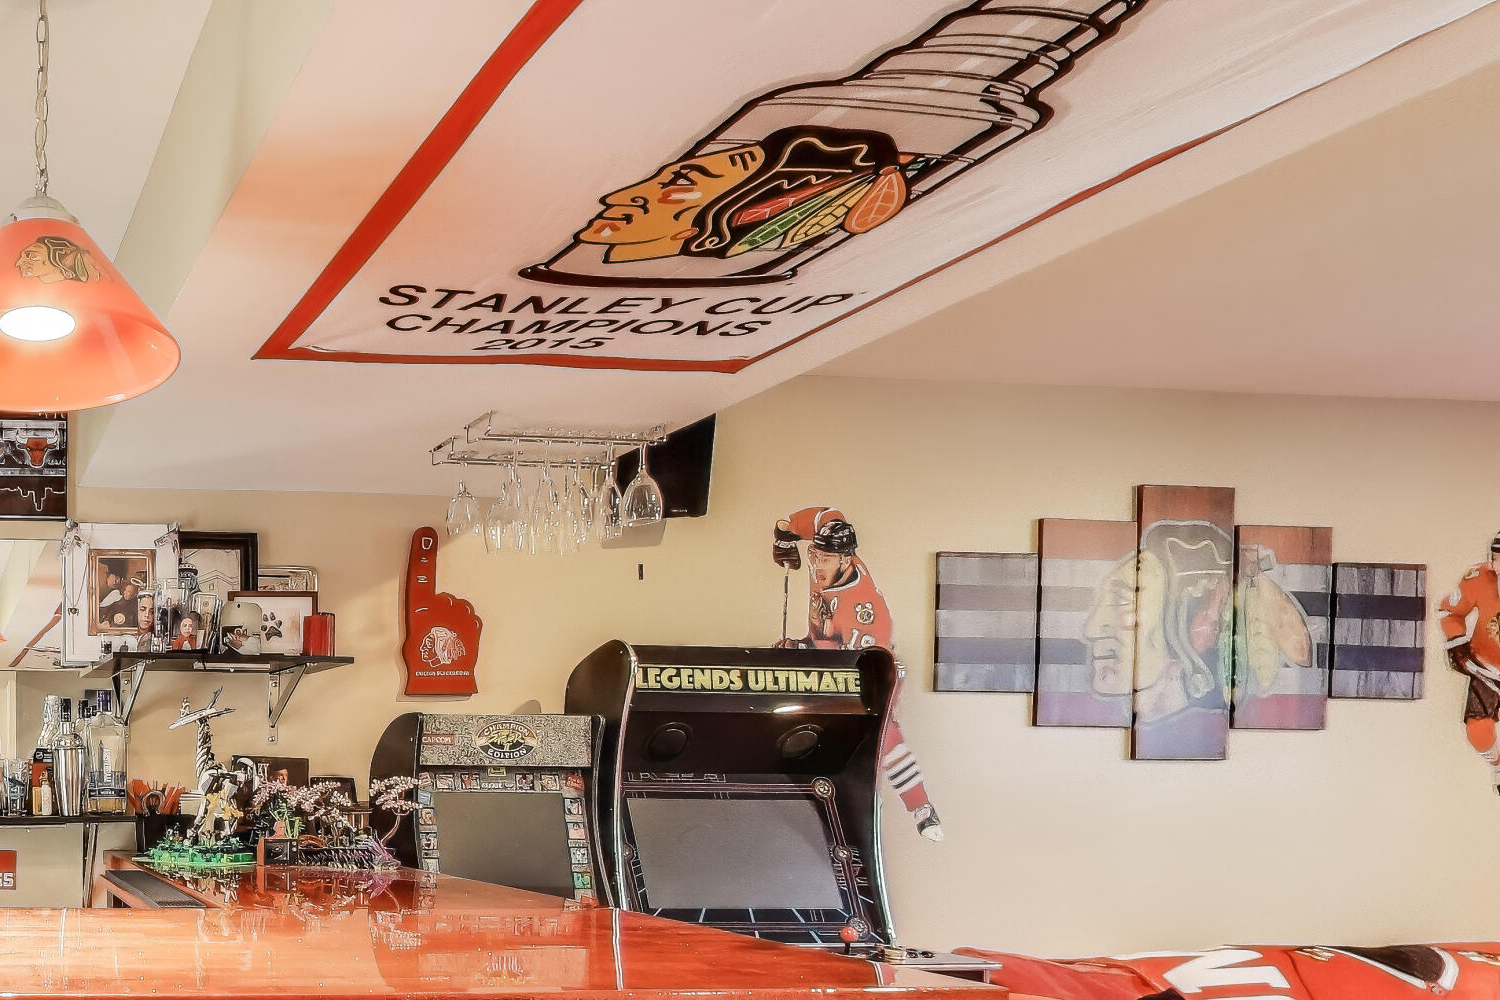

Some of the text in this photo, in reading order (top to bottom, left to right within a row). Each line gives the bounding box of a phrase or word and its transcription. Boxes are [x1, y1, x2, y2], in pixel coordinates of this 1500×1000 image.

[378, 284, 854, 316] STANLEY CUP
[385, 314, 773, 337] CHAMPIONS
[471, 336, 617, 351] 2015
[635, 667, 861, 693] LEGENDS ULTIMATE
[483, 723, 530, 738] CHAMPION
[421, 735, 452, 744] CAPCOM
[487, 748, 528, 759] EDITION
